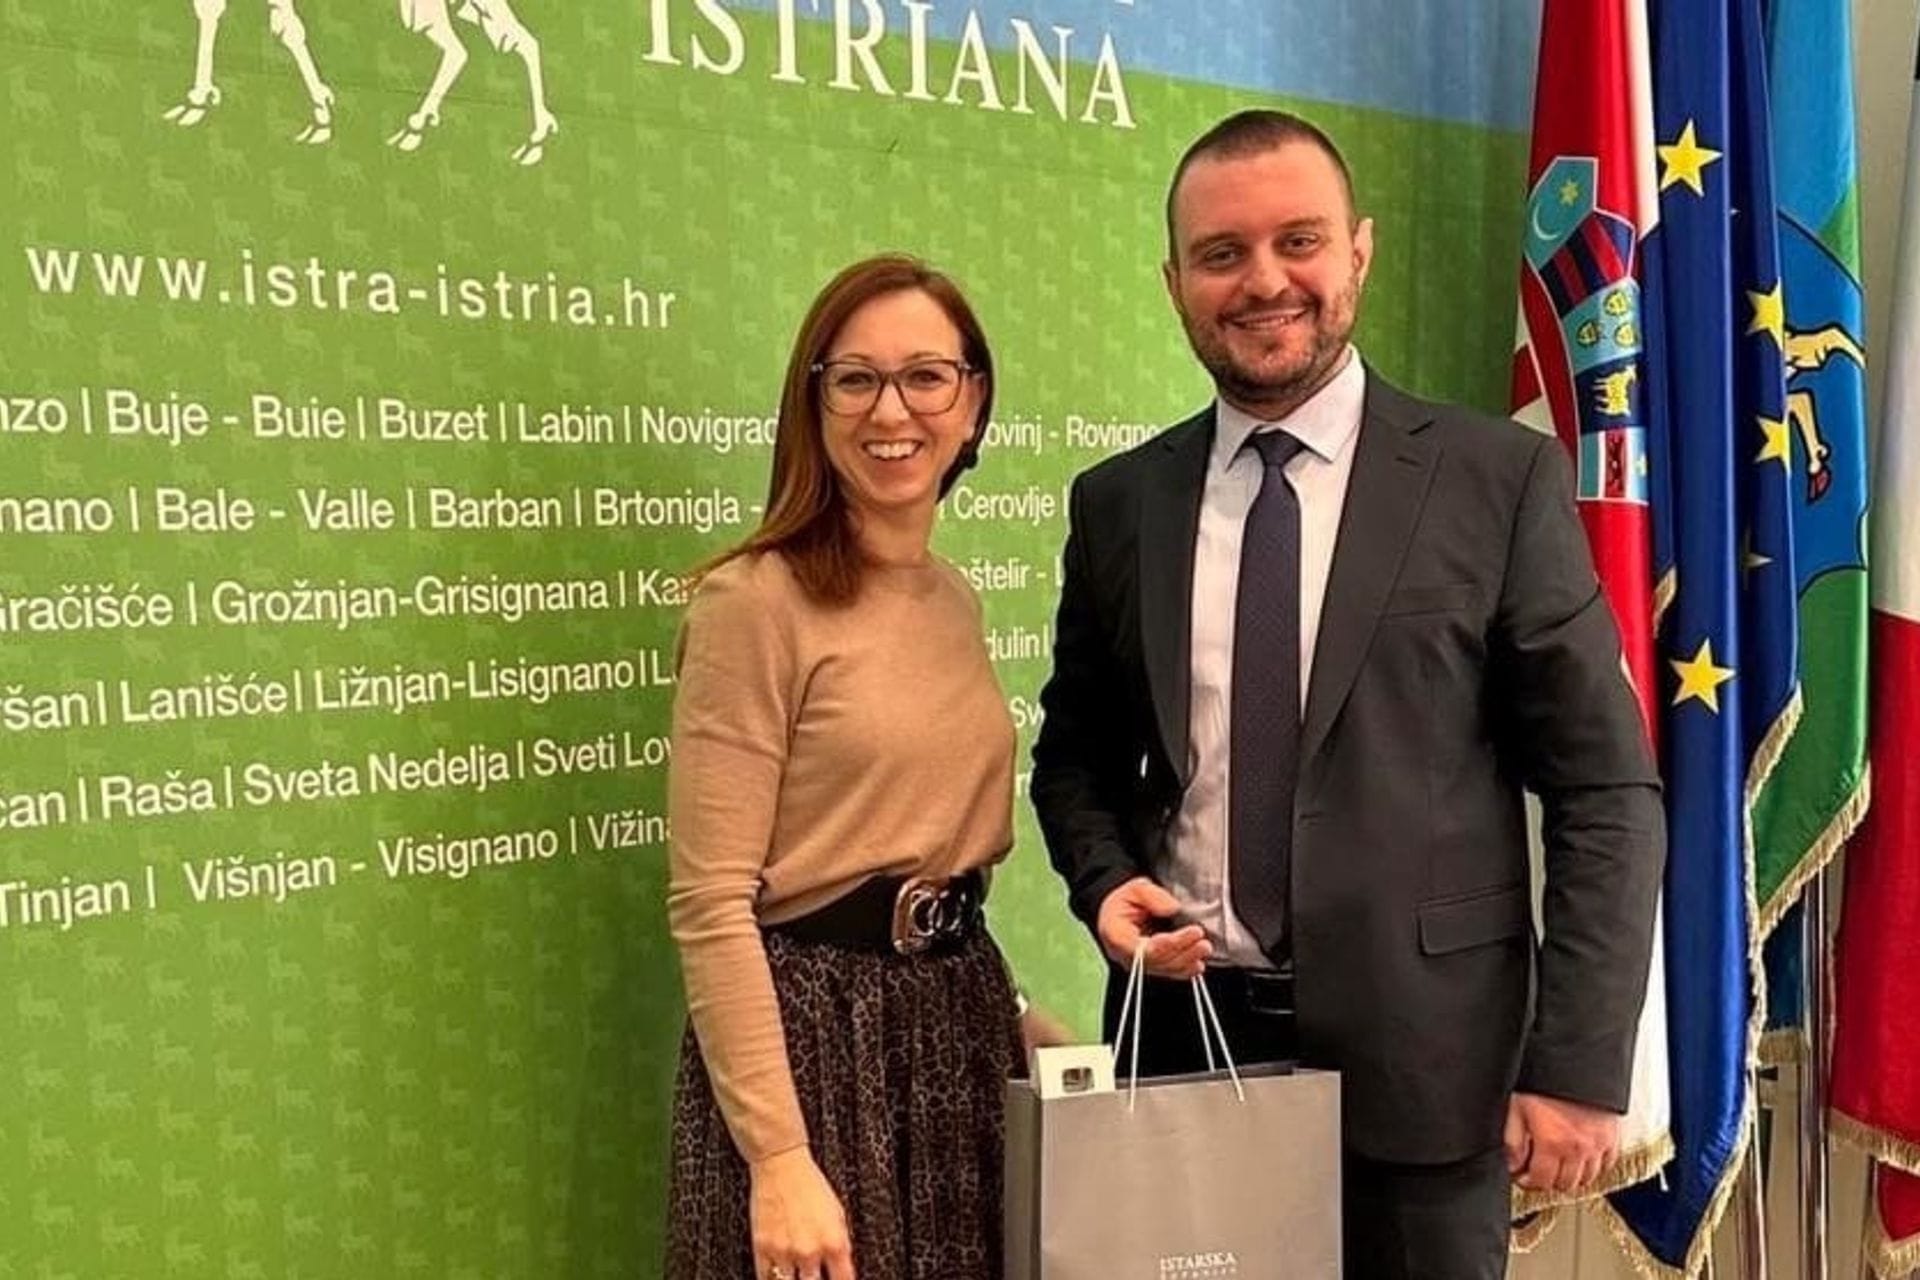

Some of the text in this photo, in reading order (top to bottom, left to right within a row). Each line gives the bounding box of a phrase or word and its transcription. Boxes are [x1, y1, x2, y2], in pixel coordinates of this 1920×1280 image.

[641, 0, 1137, 129] ISTRIANA
[25, 247, 676, 329] www.istra-istria.hr
[105, 389, 210, 447] Buje
[251, 394, 347, 439] Buie
[378, 398, 489, 442] Buzet
[518, 403, 614, 443] Labin
[984, 414, 1043, 455] ovinj
[156, 487, 256, 532] Bale
[297, 487, 395, 531] Valle
[429, 488, 562, 530] Barban
[594, 487, 742, 533] Brtonigla
[952, 484, 1057, 527] Cerovlje
[0, 582, 174, 633] račišće
[211, 574, 610, 630] Grožnjan-Grisignana
[638, 569, 700, 606] Kar
[955, 557, 1031, 592] štelir
[0, 684, 90, 731] šan
[120, 673, 288, 723] Lanišće
[314, 656, 634, 713] Ližnjan-Lisignano
[99, 769, 217, 820] Raša
[243, 760, 361, 806] Sveta
[368, 748, 510, 794] Nedelja
[532, 732, 617, 777] Sveti
[0, 875, 130, 932] Tinjan
[183, 852, 336, 904] Višnjan
[377, 829, 558, 884] Visignano
[587, 810, 672, 851] Vižin
